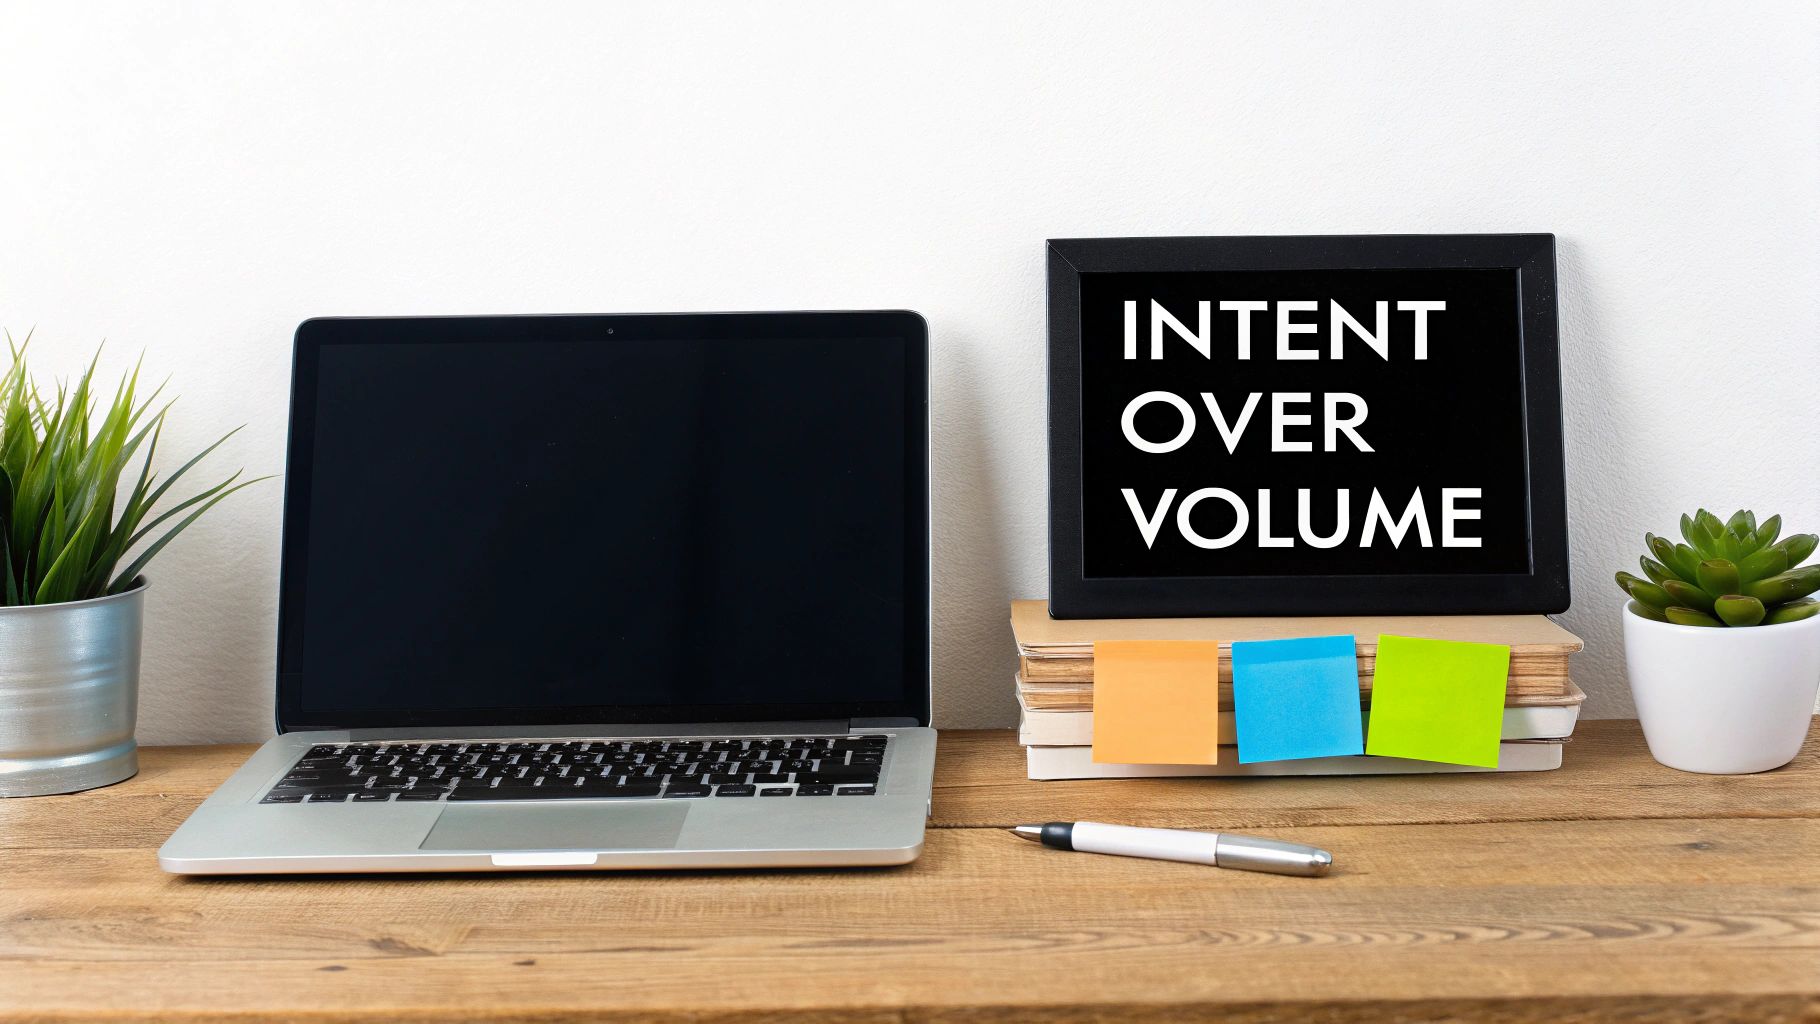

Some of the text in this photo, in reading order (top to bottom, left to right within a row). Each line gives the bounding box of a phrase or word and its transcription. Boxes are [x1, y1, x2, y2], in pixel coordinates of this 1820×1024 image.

[1124, 299, 1447, 361] INTENT
[1121, 391, 1376, 454] OVER
[1121, 486, 1482, 550] VOLUME
